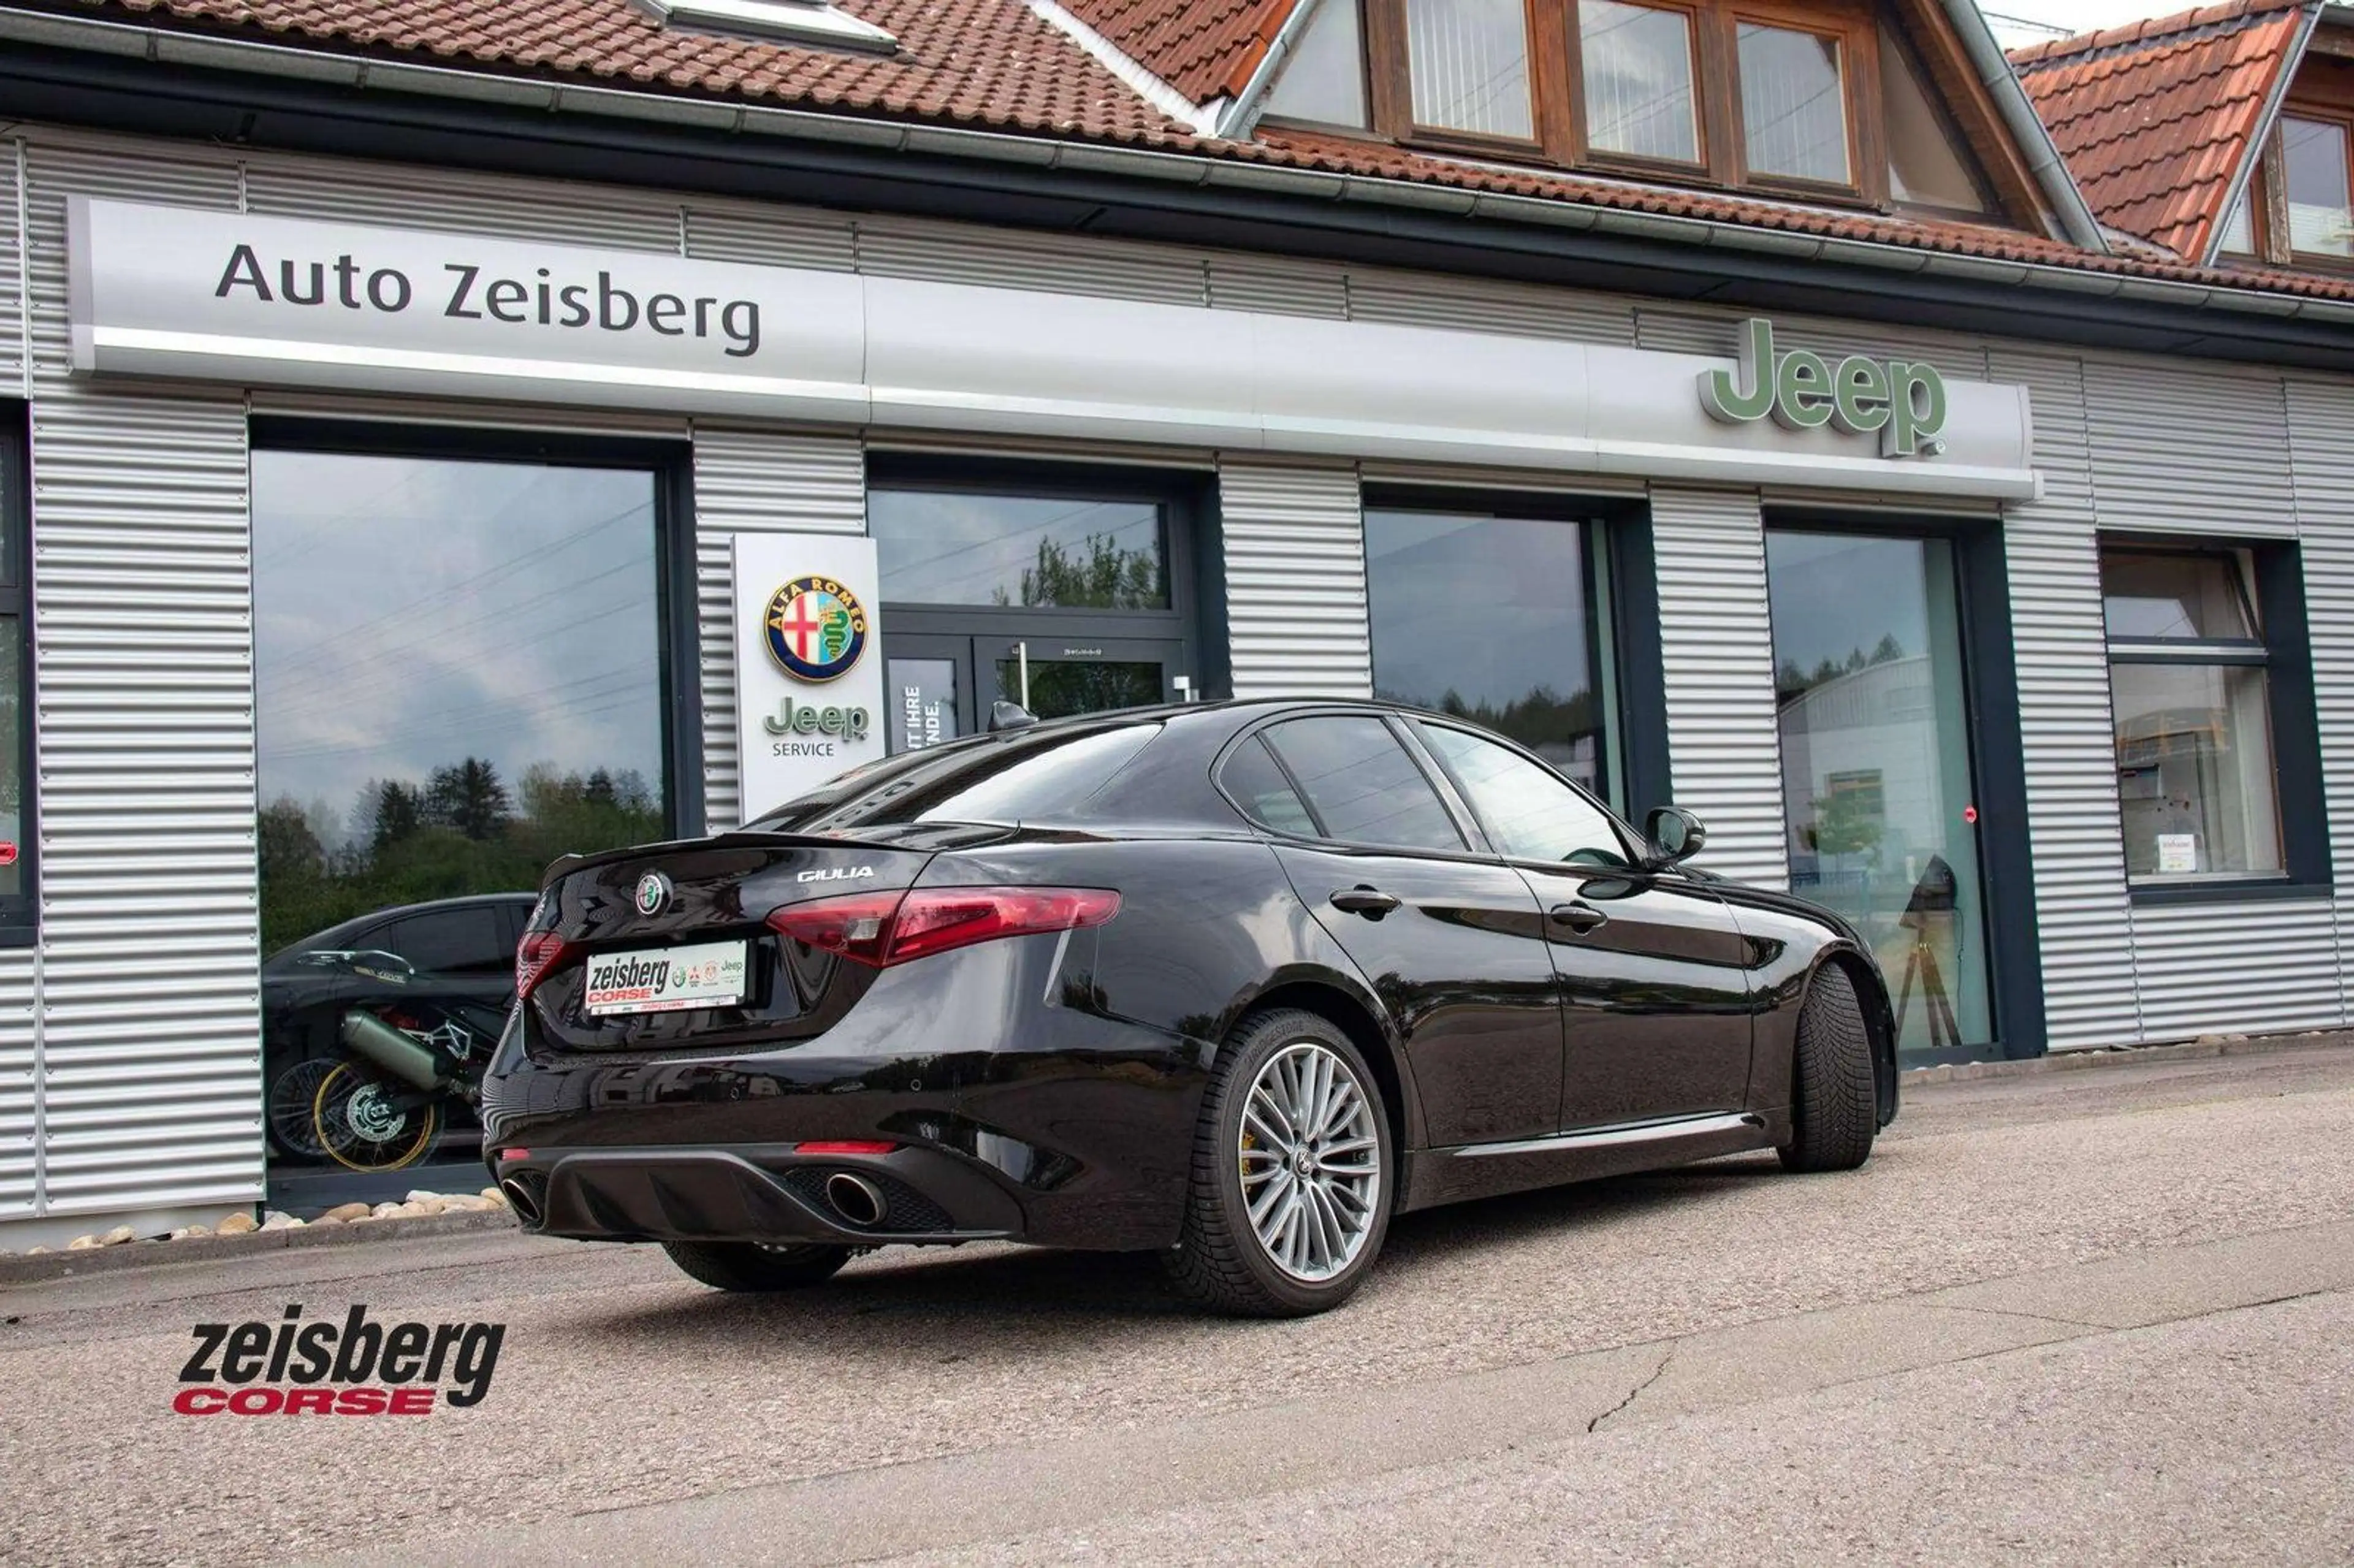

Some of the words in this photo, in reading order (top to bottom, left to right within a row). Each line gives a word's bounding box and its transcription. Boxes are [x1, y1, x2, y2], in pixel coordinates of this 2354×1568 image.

[215, 244, 411, 313] Auto
[443, 262, 760, 357] Zeisberg
[1699, 318, 1946, 457] Jeep
[769, 584, 804, 630] ALFA
[811, 578, 864, 633] ROMEO
[764, 696, 869, 742] Jeep
[905, 687, 920, 728] IHRE
[924, 701, 940, 746] NDE.
[772, 742, 835, 757] SERVICE
[797, 866, 875, 883] GIULIA
[587, 987, 653, 1003] CORSE
[589, 956, 670, 994] zeisberg
